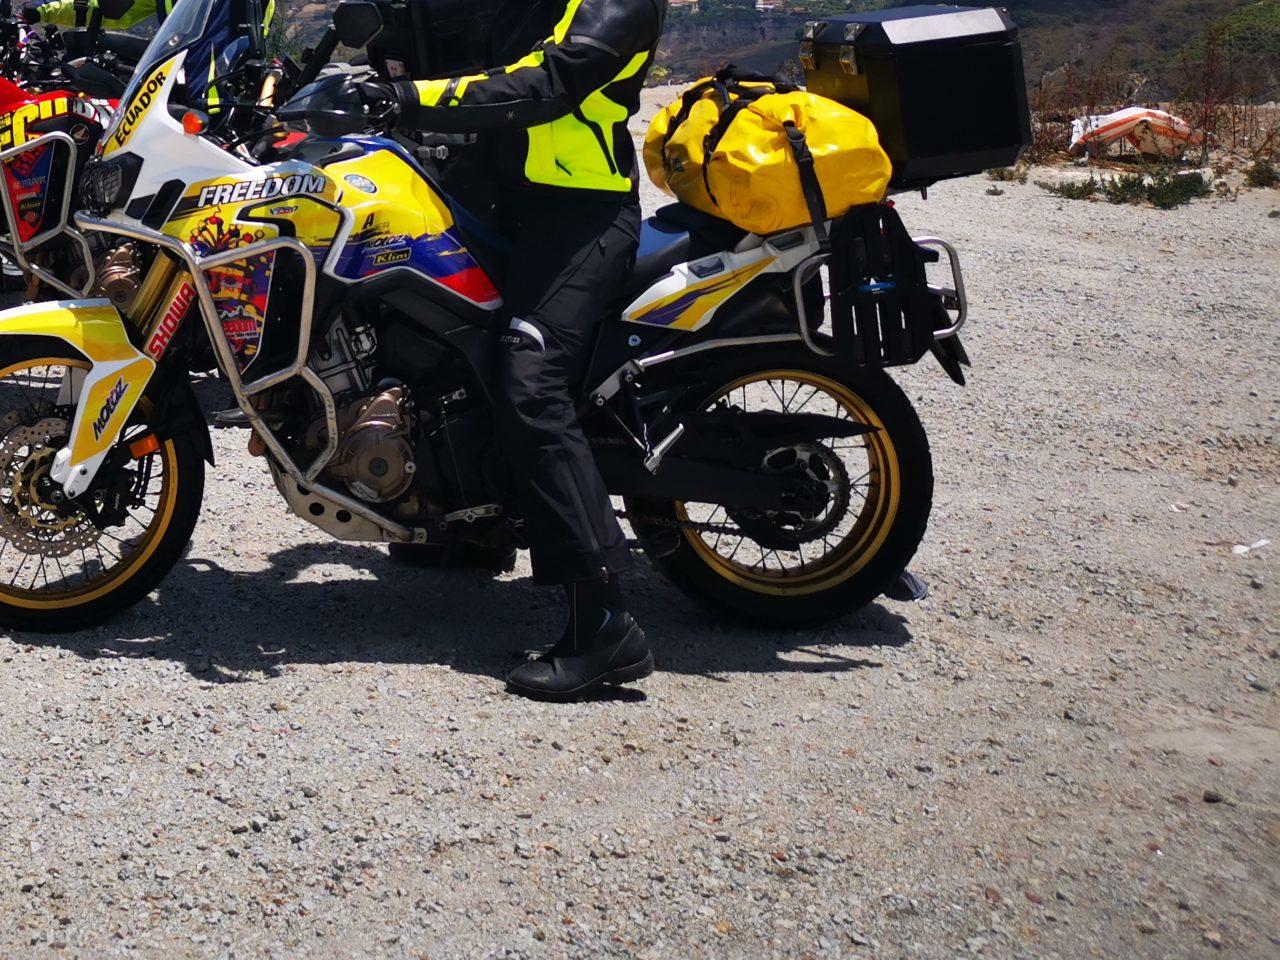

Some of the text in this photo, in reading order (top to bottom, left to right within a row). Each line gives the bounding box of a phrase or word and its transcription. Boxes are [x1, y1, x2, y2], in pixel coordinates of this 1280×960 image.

[115, 71, 167, 148] ECUADOR
[197, 173, 326, 208] FREEDOM
[148, 282, 198, 361] SHOWA
